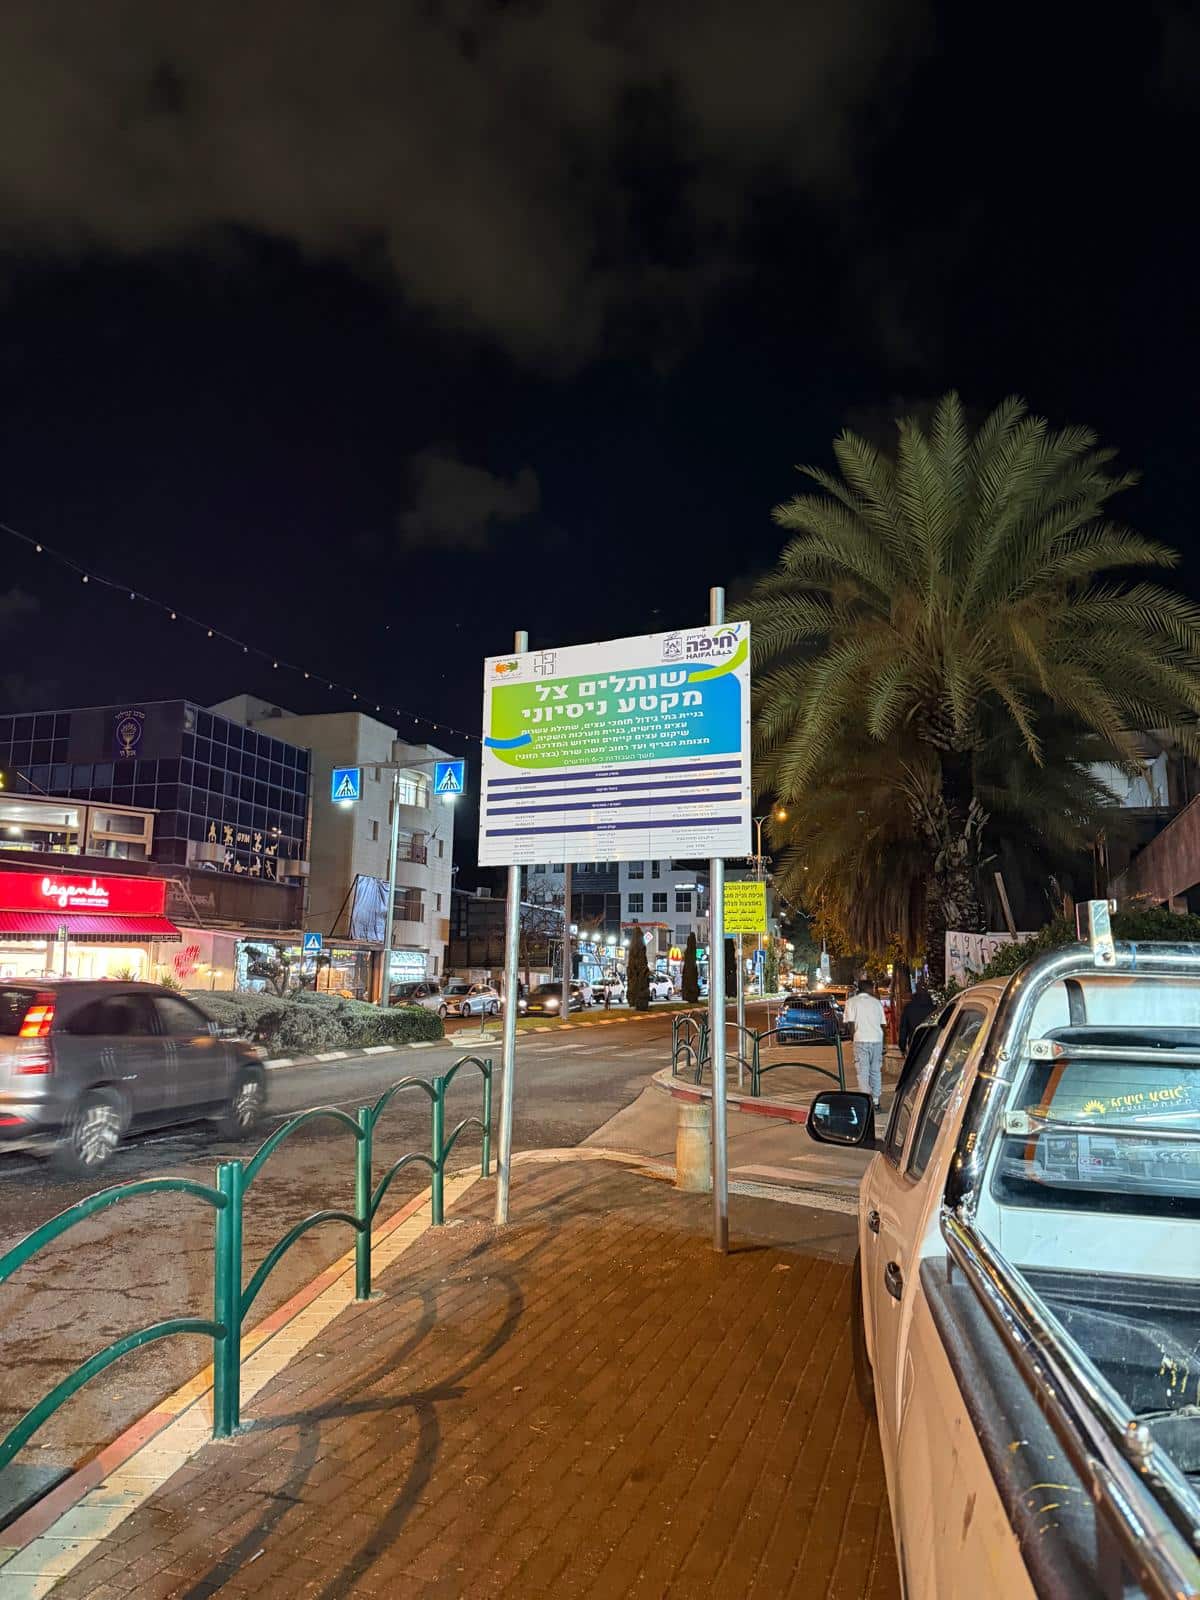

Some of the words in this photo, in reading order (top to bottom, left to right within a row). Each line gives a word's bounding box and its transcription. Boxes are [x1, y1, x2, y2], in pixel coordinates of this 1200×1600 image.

[686, 635, 733, 653] חיפה
[686, 651, 711, 660] HAIFA
[578, 670, 687, 697] שותלים
[535, 684, 569, 702] צל
[617, 690, 703, 714] מקטע
[521, 700, 608, 724] ניסיוני
[679, 711, 704, 719] בניית
[635, 715, 658, 725] גידול
[660, 713, 677, 721] בתי
[550, 723, 579, 733] שתילת
[664, 721, 688, 730] עצים
[568, 730, 600, 739] מערכות
[635, 733, 657, 741] עצים
[660, 730, 689, 739] שיקום
[649, 741, 677, 750] הצריף
[679, 737, 710, 746] מצומת
[608, 745, 629, 753] רחוב
[631, 743, 647, 751] ועד
[604, 754, 636, 762] העבודות
[638, 752, 655, 760] משך
